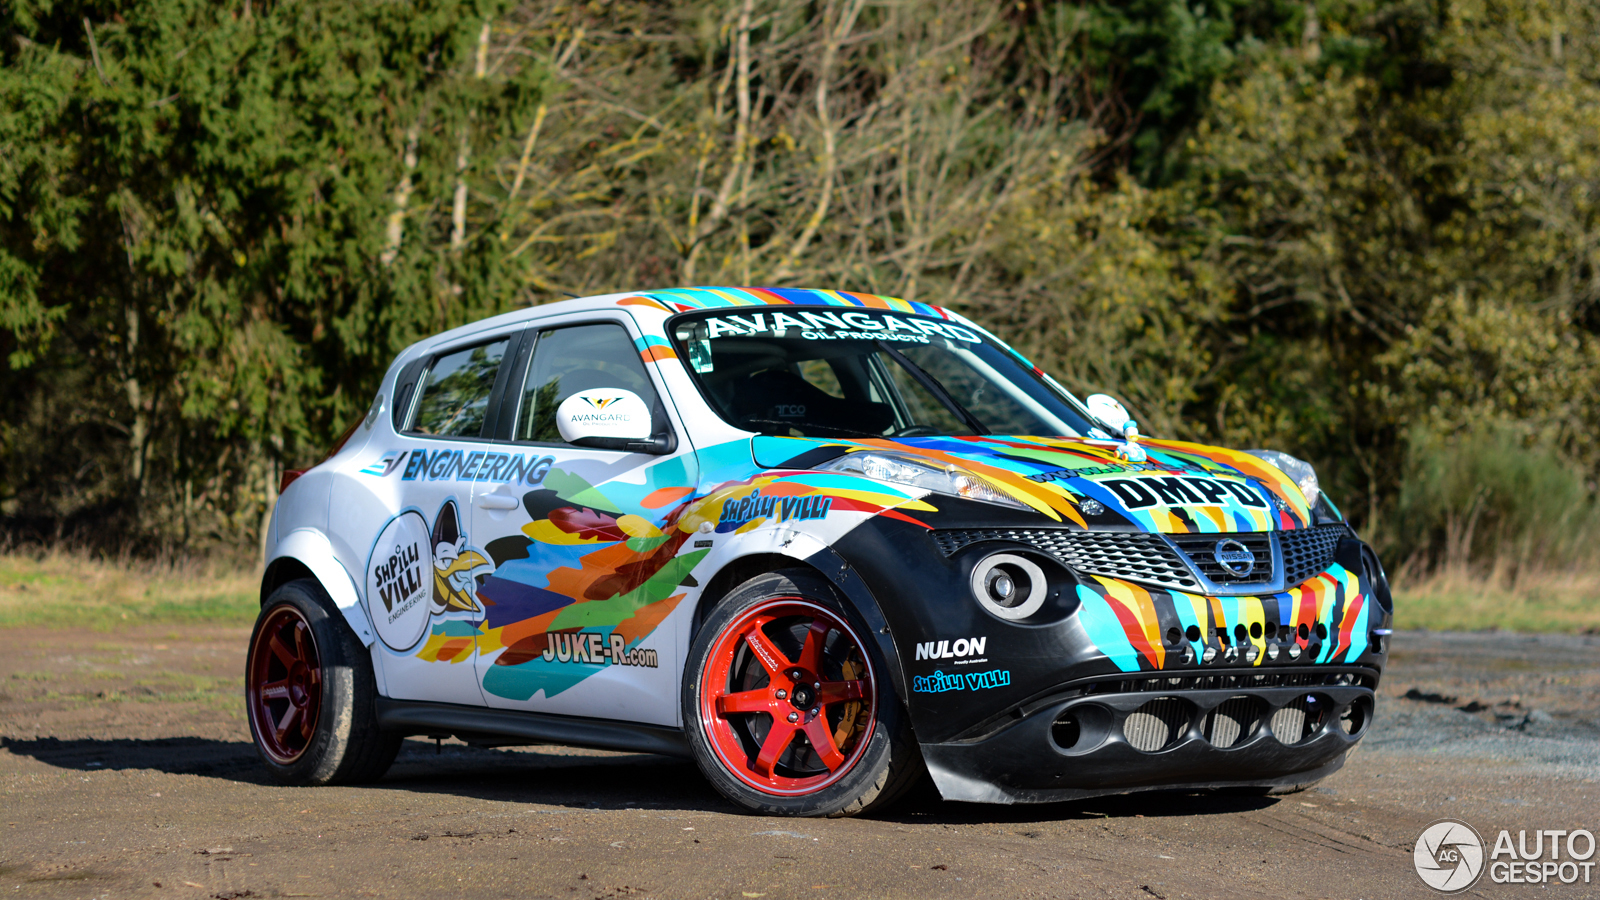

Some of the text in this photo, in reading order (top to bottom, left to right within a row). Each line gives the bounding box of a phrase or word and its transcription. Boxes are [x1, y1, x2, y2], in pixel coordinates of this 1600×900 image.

[705, 312, 982, 344] AVANGARD
[801, 331, 930, 344] OIL PRODUCTS
[571, 413, 631, 423] AVANGARD
[401, 448, 556, 487] ENGINEERING
[379, 565, 422, 614] VILLI
[388, 589, 426, 624] ENGINEERING
[542, 631, 658, 668] JUKE-R.com
[915, 636, 987, 661] NULON
